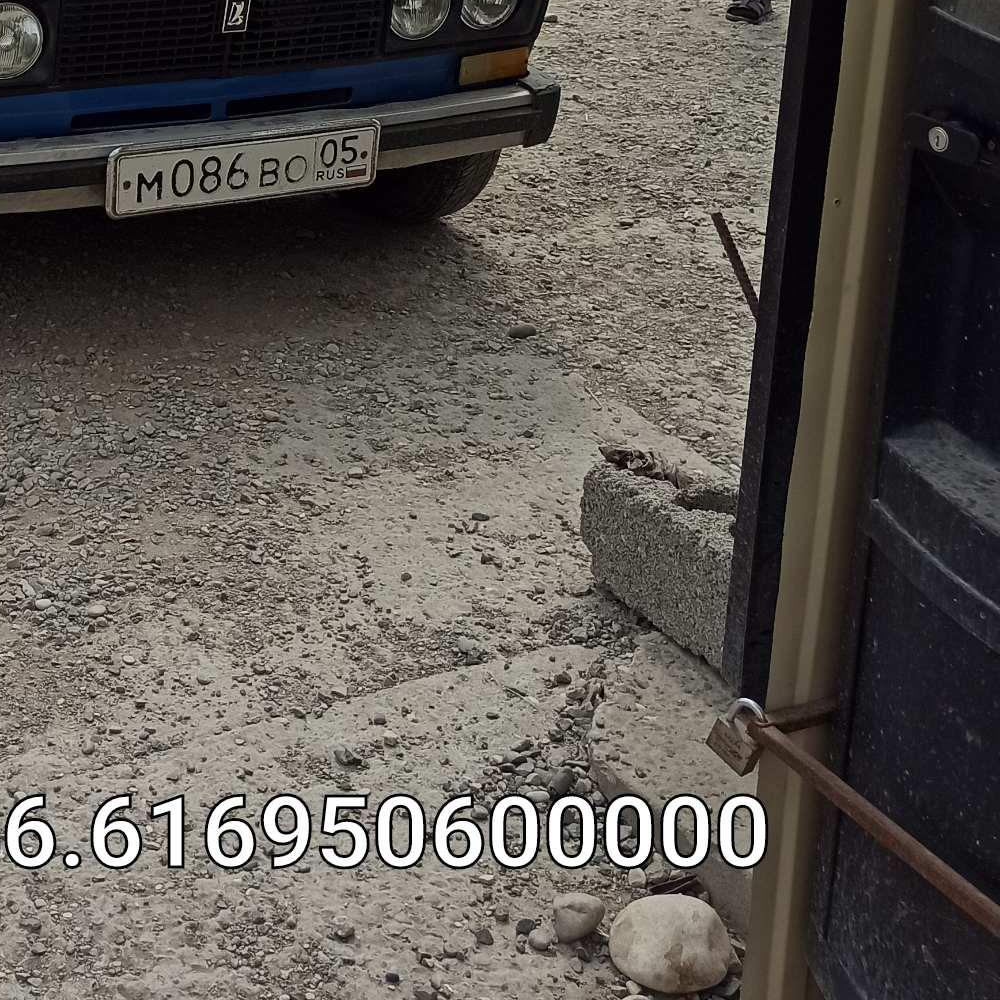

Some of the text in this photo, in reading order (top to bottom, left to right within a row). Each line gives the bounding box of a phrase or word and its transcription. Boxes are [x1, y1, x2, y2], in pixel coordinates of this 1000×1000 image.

[136, 135, 358, 203] М086ВО 05
[315, 168, 345, 182] RUS
